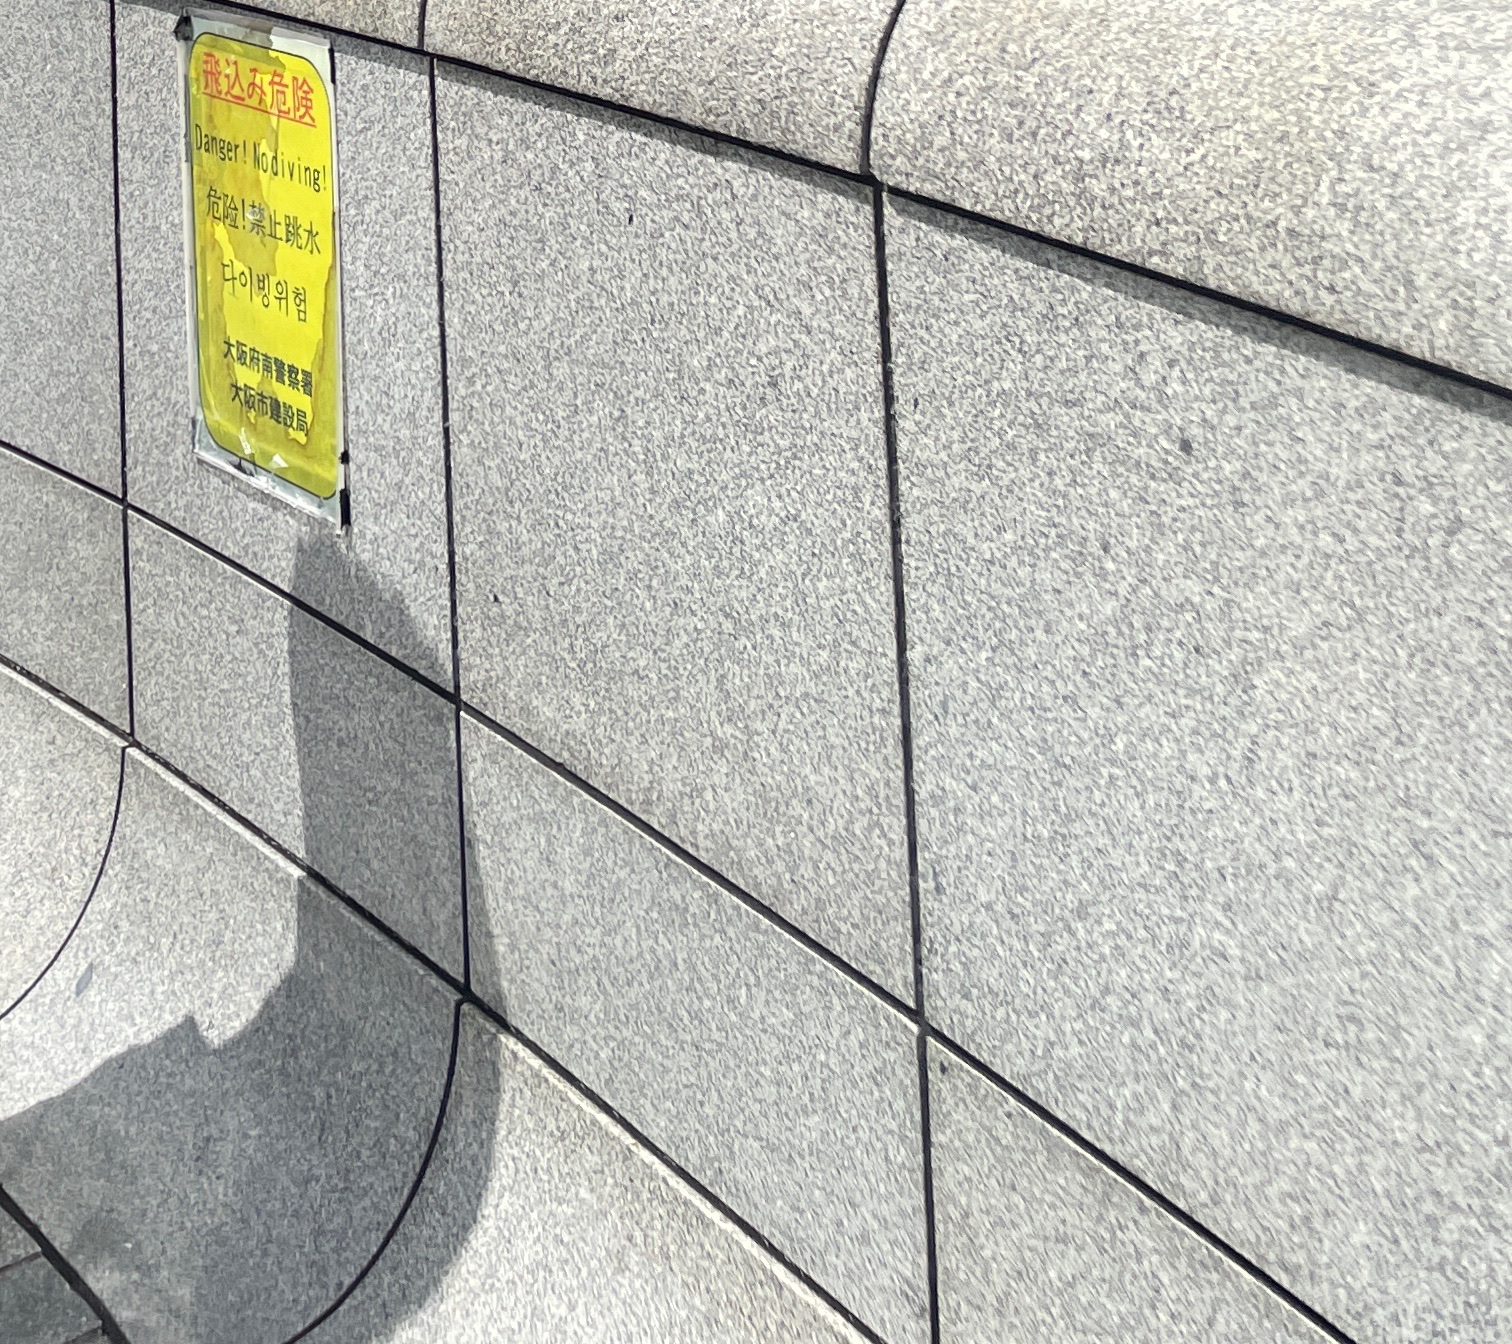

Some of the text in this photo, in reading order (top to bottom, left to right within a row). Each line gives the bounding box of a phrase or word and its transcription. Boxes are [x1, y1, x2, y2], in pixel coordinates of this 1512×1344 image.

[202, 52, 316, 123] 飛込み危険
[195, 123, 247, 164] Danger!
[221, 258, 307, 323] 다이빙위험
[223, 335, 313, 398] 大阪府南警察署
[230, 379, 309, 437] 大阪市建設局
